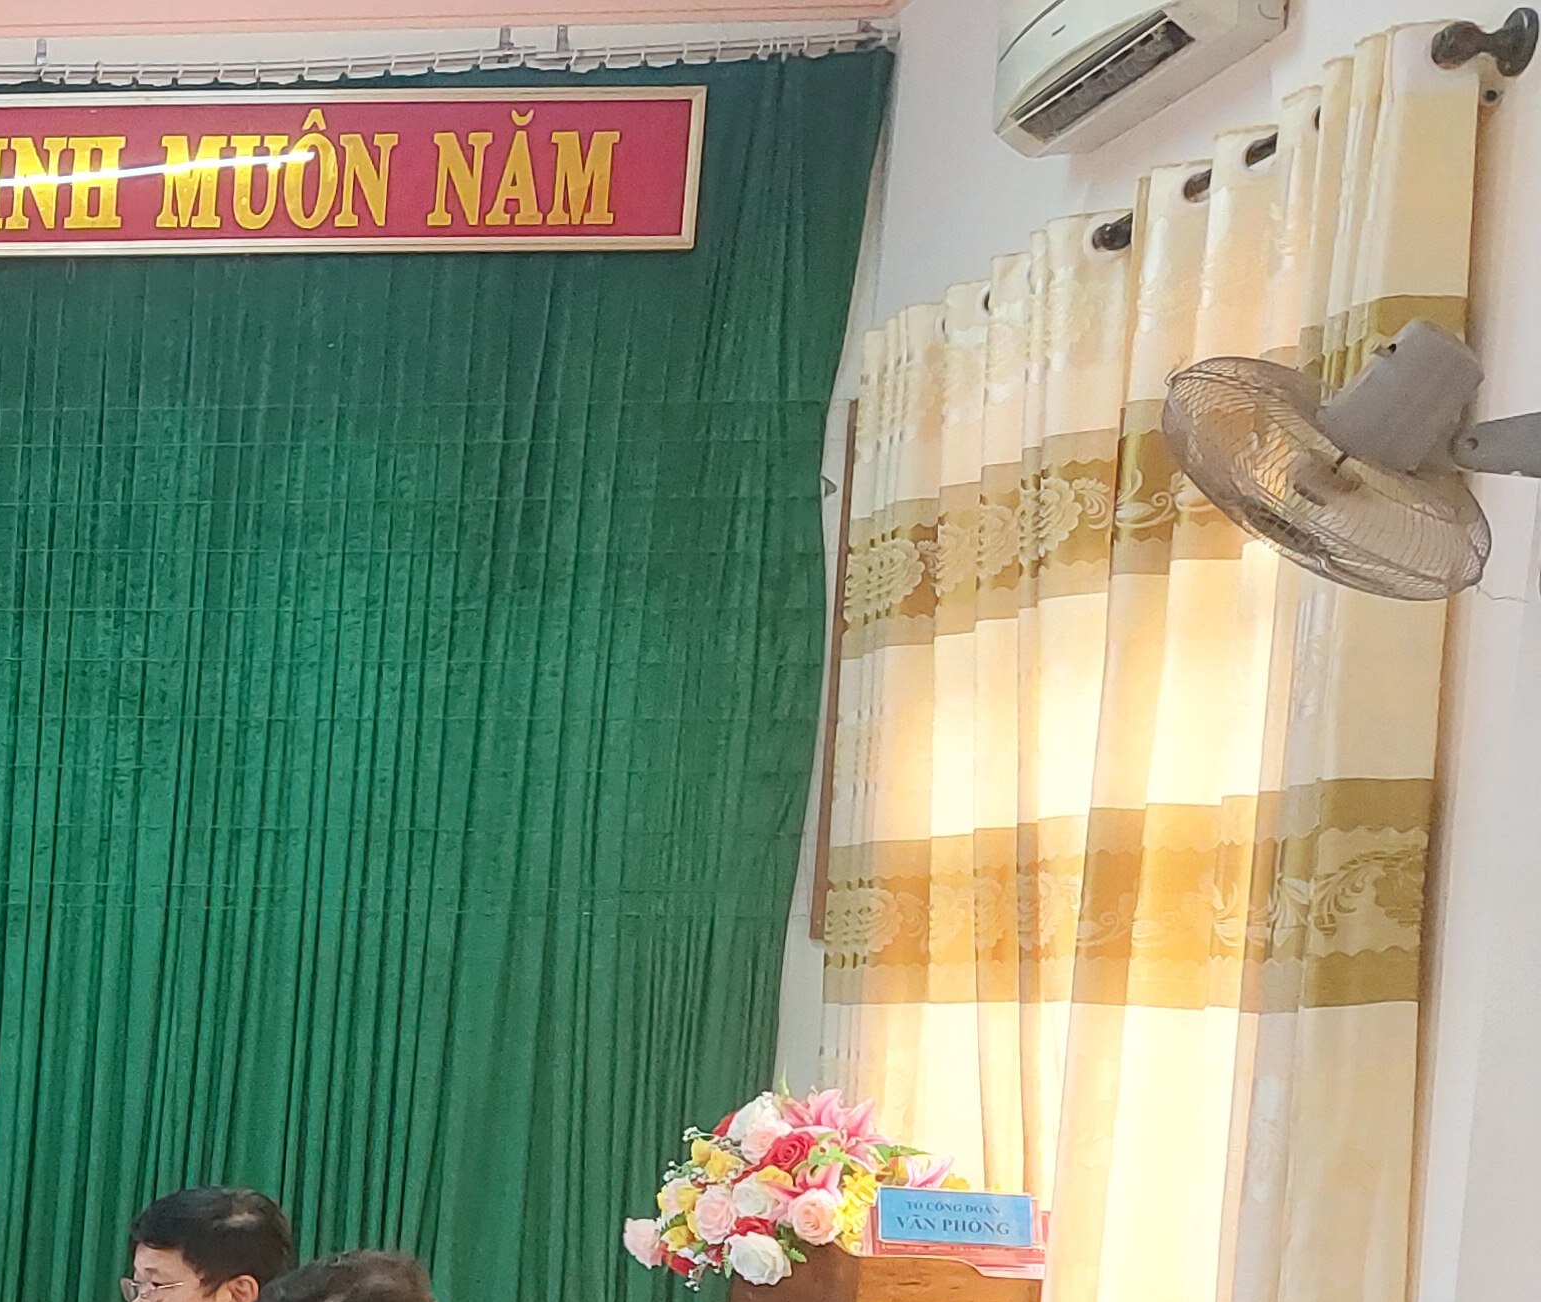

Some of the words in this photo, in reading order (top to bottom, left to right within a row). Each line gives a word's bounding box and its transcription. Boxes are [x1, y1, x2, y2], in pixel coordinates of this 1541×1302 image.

[156, 109, 399, 230] MUÔN
[426, 108, 621, 226] NĂM
[926, 1200, 963, 1212] CÔNG
[897, 1213, 936, 1230] VĂN
